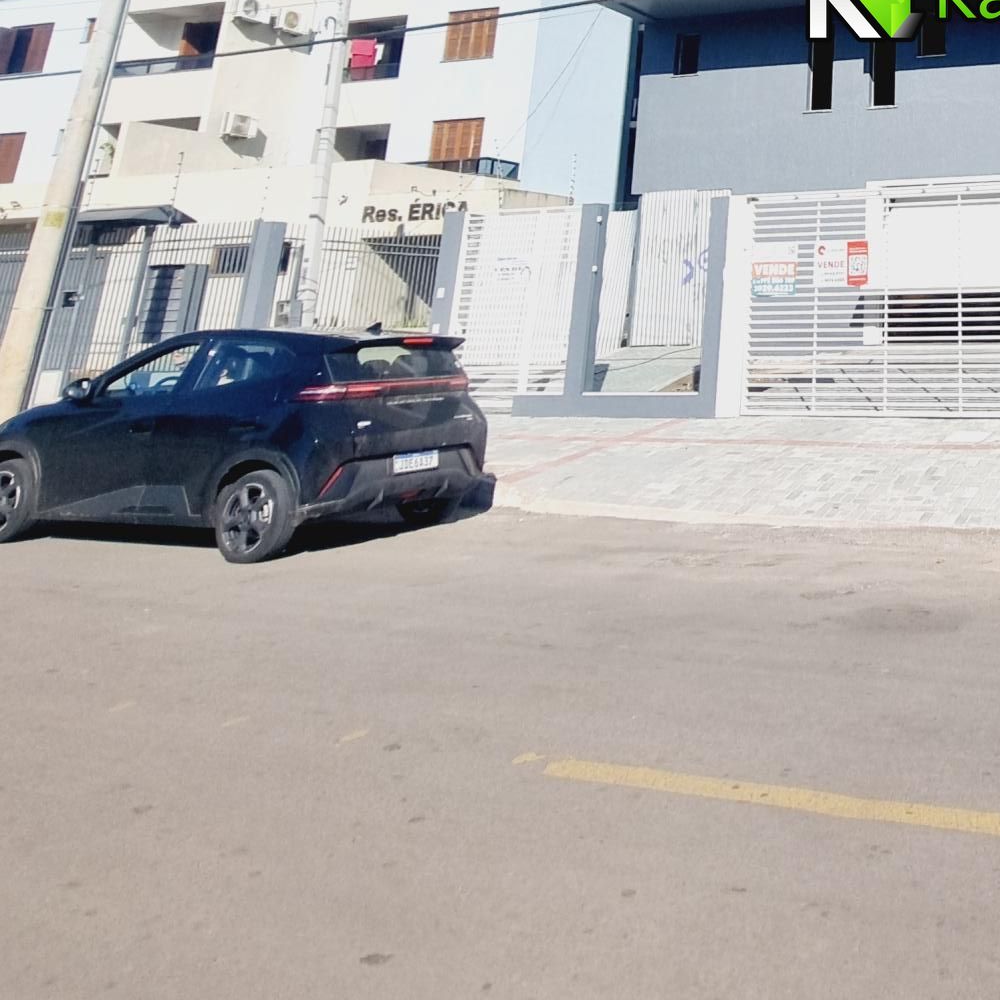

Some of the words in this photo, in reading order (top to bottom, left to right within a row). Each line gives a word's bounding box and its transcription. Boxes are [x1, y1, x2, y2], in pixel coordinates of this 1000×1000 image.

[362, 205, 403, 223] Res.
[753, 263, 795, 276] VENDE
[818, 260, 845, 268] VENDE
